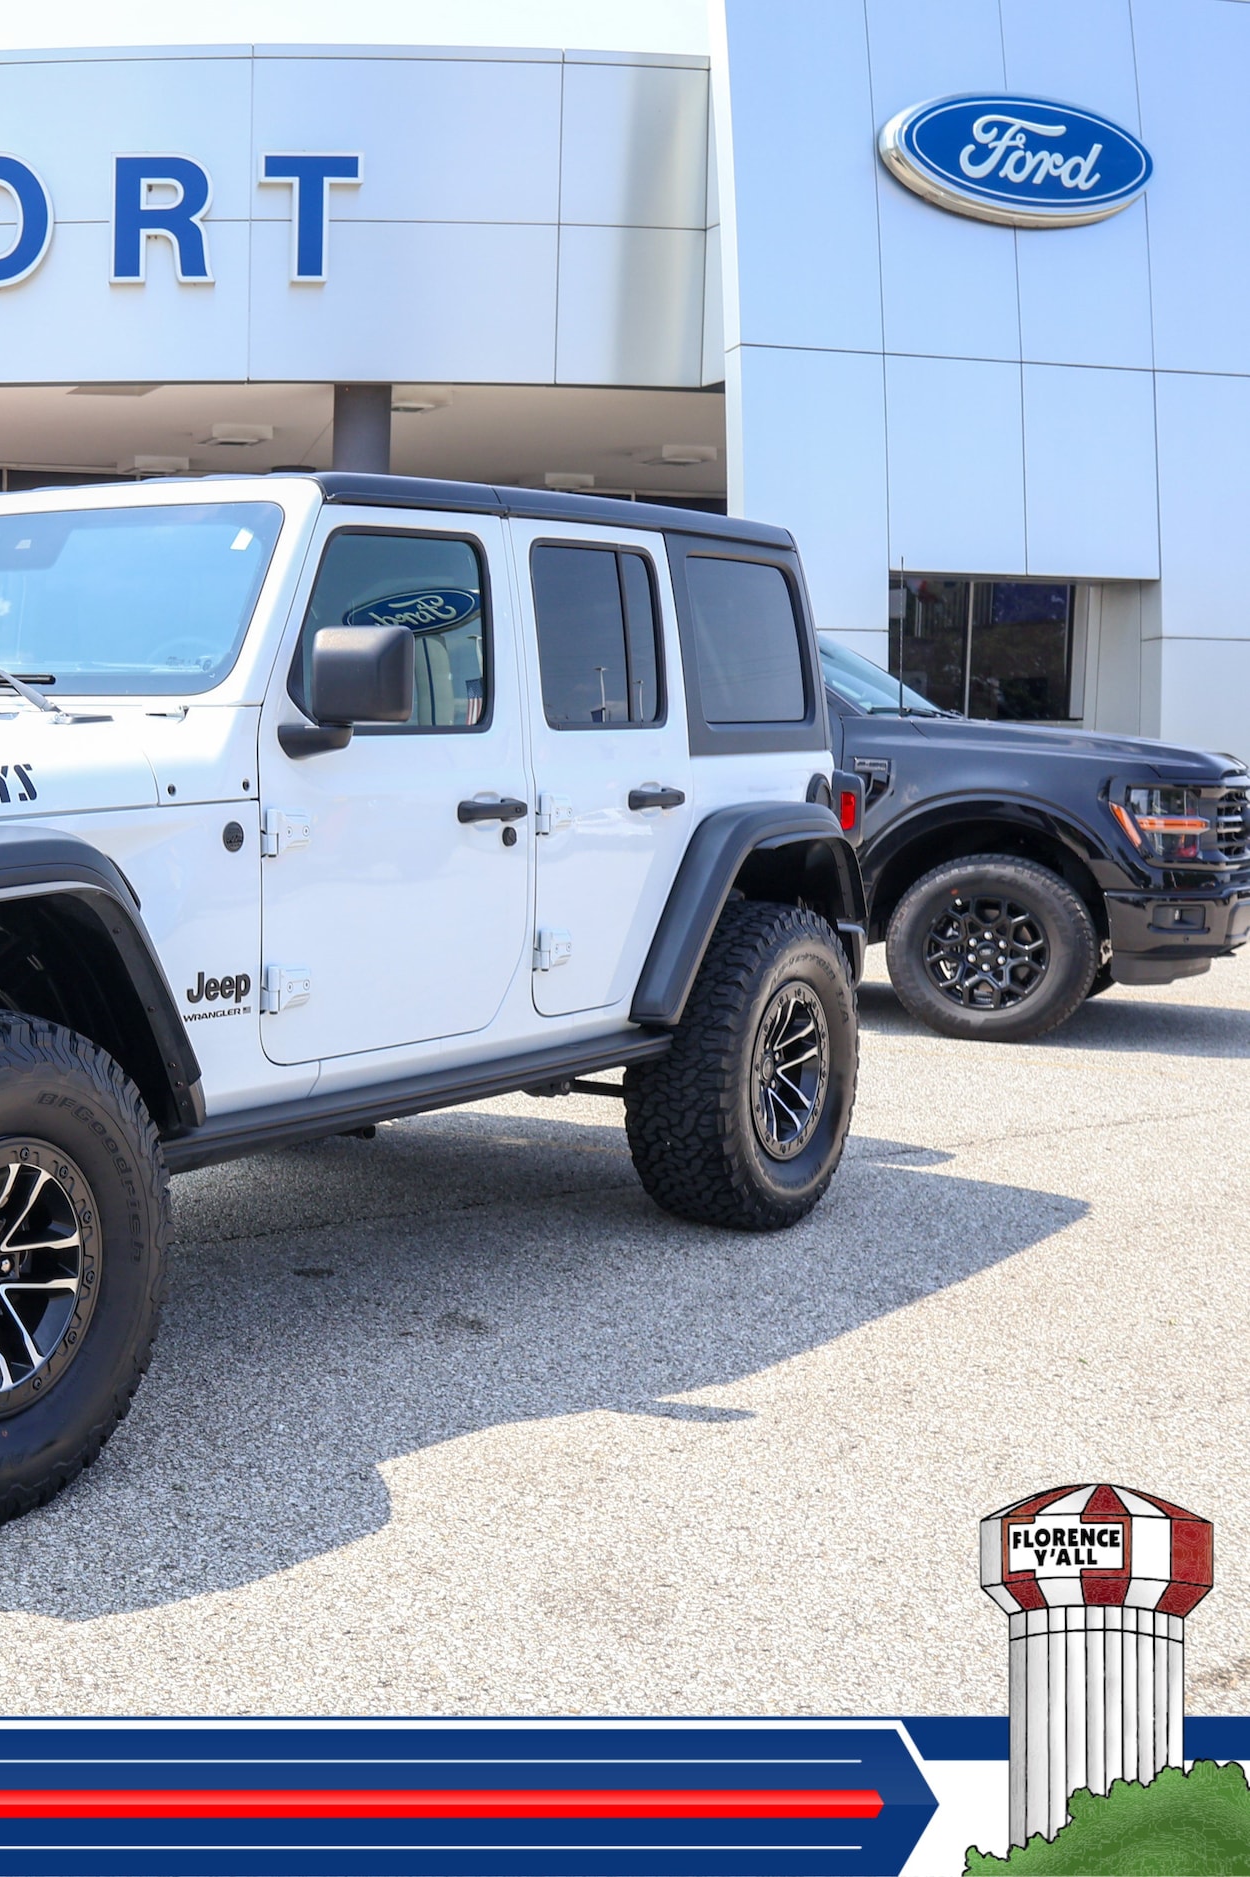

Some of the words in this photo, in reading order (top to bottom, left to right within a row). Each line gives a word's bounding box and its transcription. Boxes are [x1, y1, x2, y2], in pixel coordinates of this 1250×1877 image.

[958, 113, 1103, 191] Ford
[183, 1007, 241, 1022] WRANGLER
[186, 971, 251, 1004] Jeep
[37, 1091, 145, 1263] BFGoodrich
